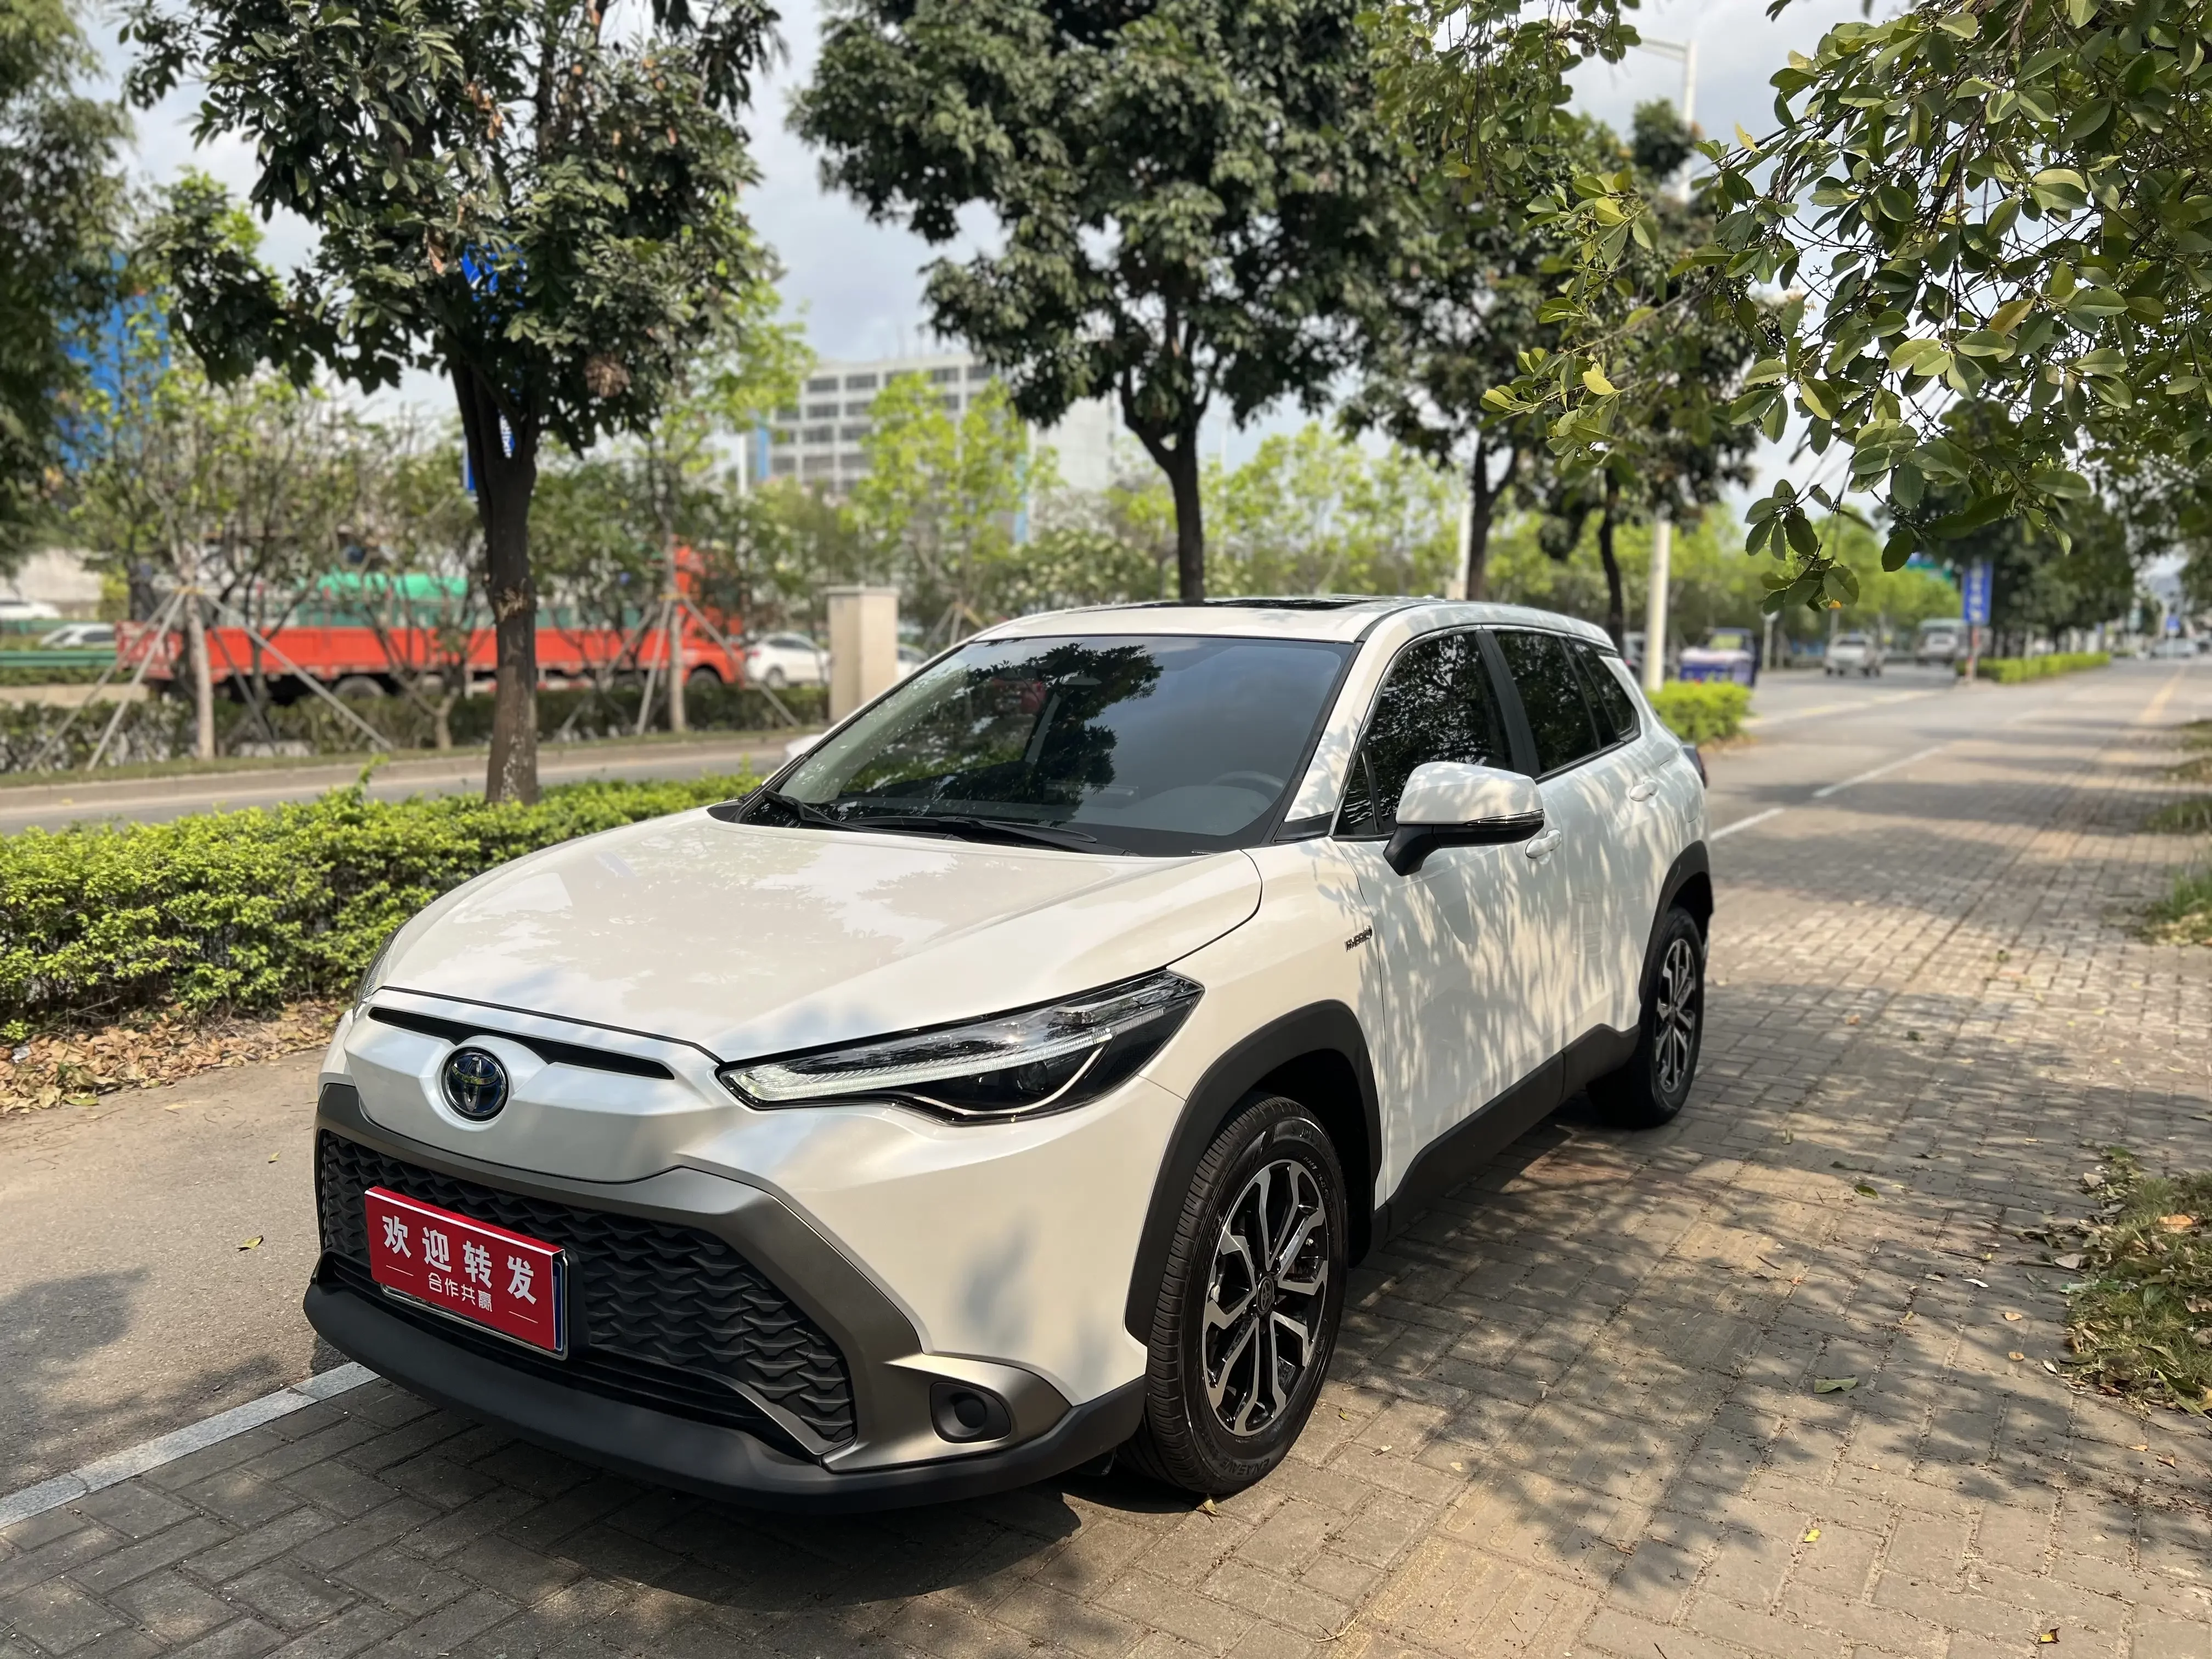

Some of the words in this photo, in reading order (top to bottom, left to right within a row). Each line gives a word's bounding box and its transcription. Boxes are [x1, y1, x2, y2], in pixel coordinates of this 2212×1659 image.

[382, 1215, 537, 1305] 欢迎转发
[428, 1272, 493, 1312] 合作共赢
